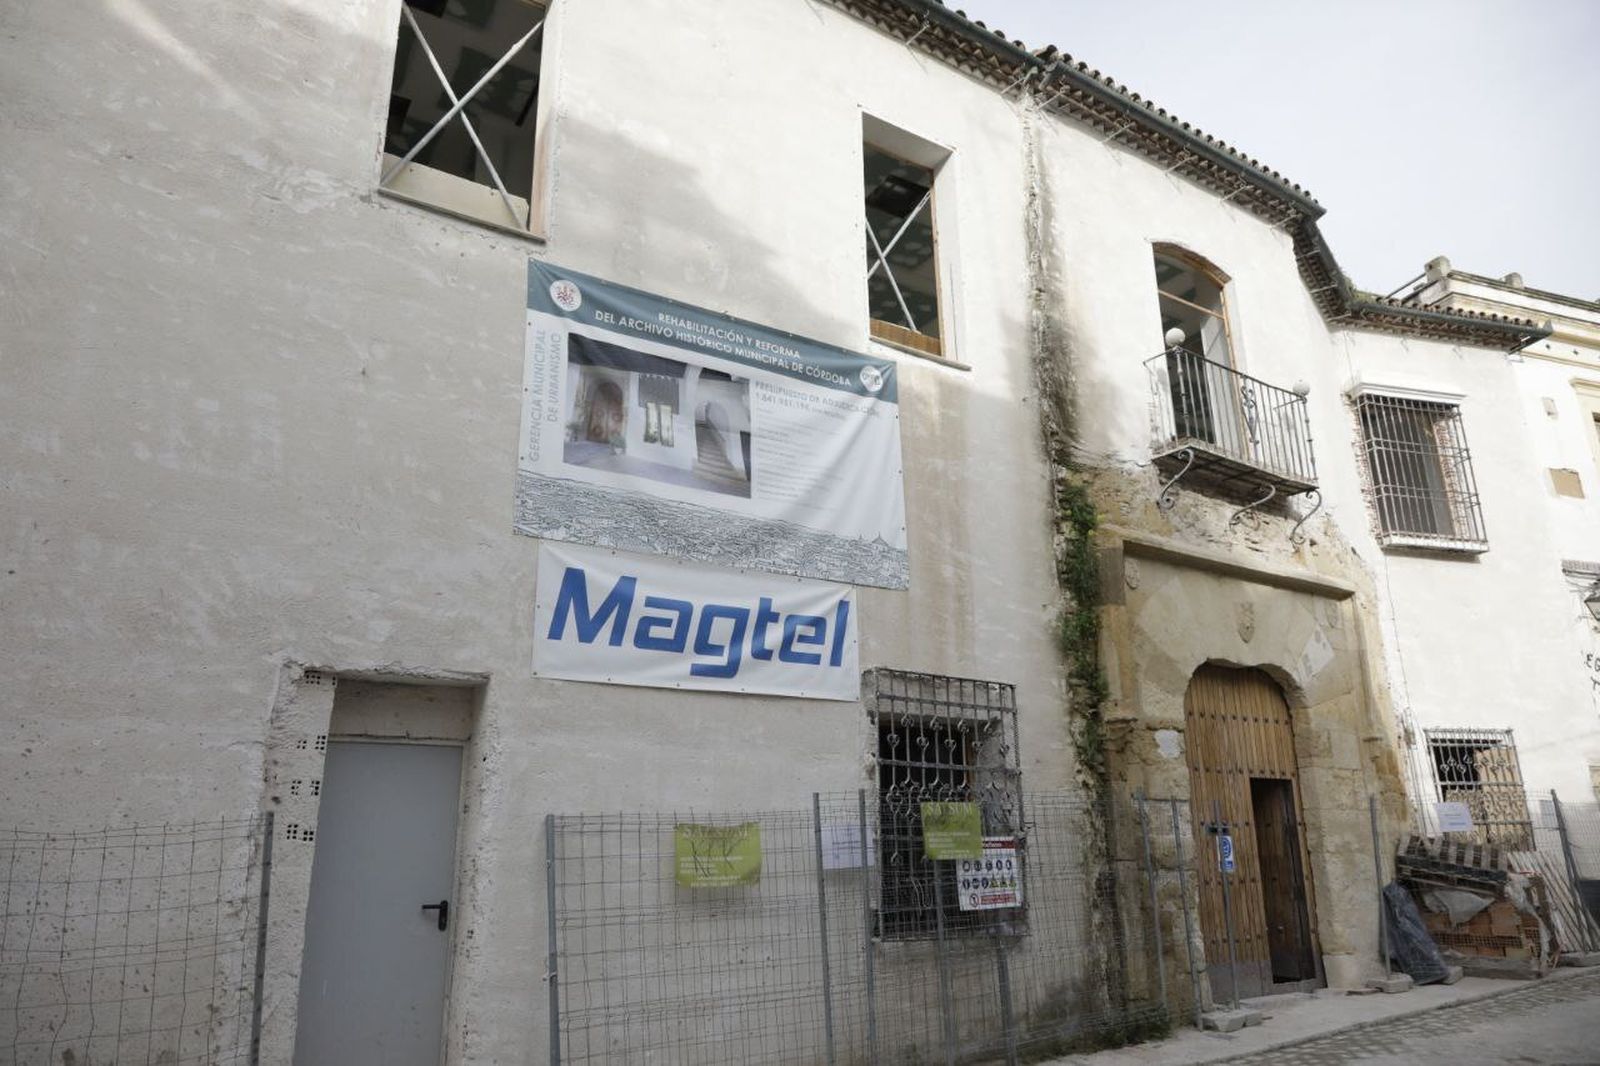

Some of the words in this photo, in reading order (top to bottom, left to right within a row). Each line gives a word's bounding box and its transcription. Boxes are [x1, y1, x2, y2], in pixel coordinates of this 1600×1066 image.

[532, 330, 546, 395] MUNICIPAL
[595, 310, 616, 325] DEL
[618, 316, 673, 338] ARCHIVO
[676, 330, 732, 353] HISTÓRICO
[735, 347, 790, 369] MUNICIPAL
[791, 362, 803, 374] DE
[805, 365, 852, 386] CÓRDOBA
[658, 312, 743, 343] REHABILITACIÓN
[747, 336, 753, 344] Y
[755, 339, 800, 359] REFORMA
[549, 333, 561, 404] URBANISMO
[528, 401, 542, 462] GERENCIA
[547, 408, 559, 423] DE
[547, 567, 850, 679] Magtel
